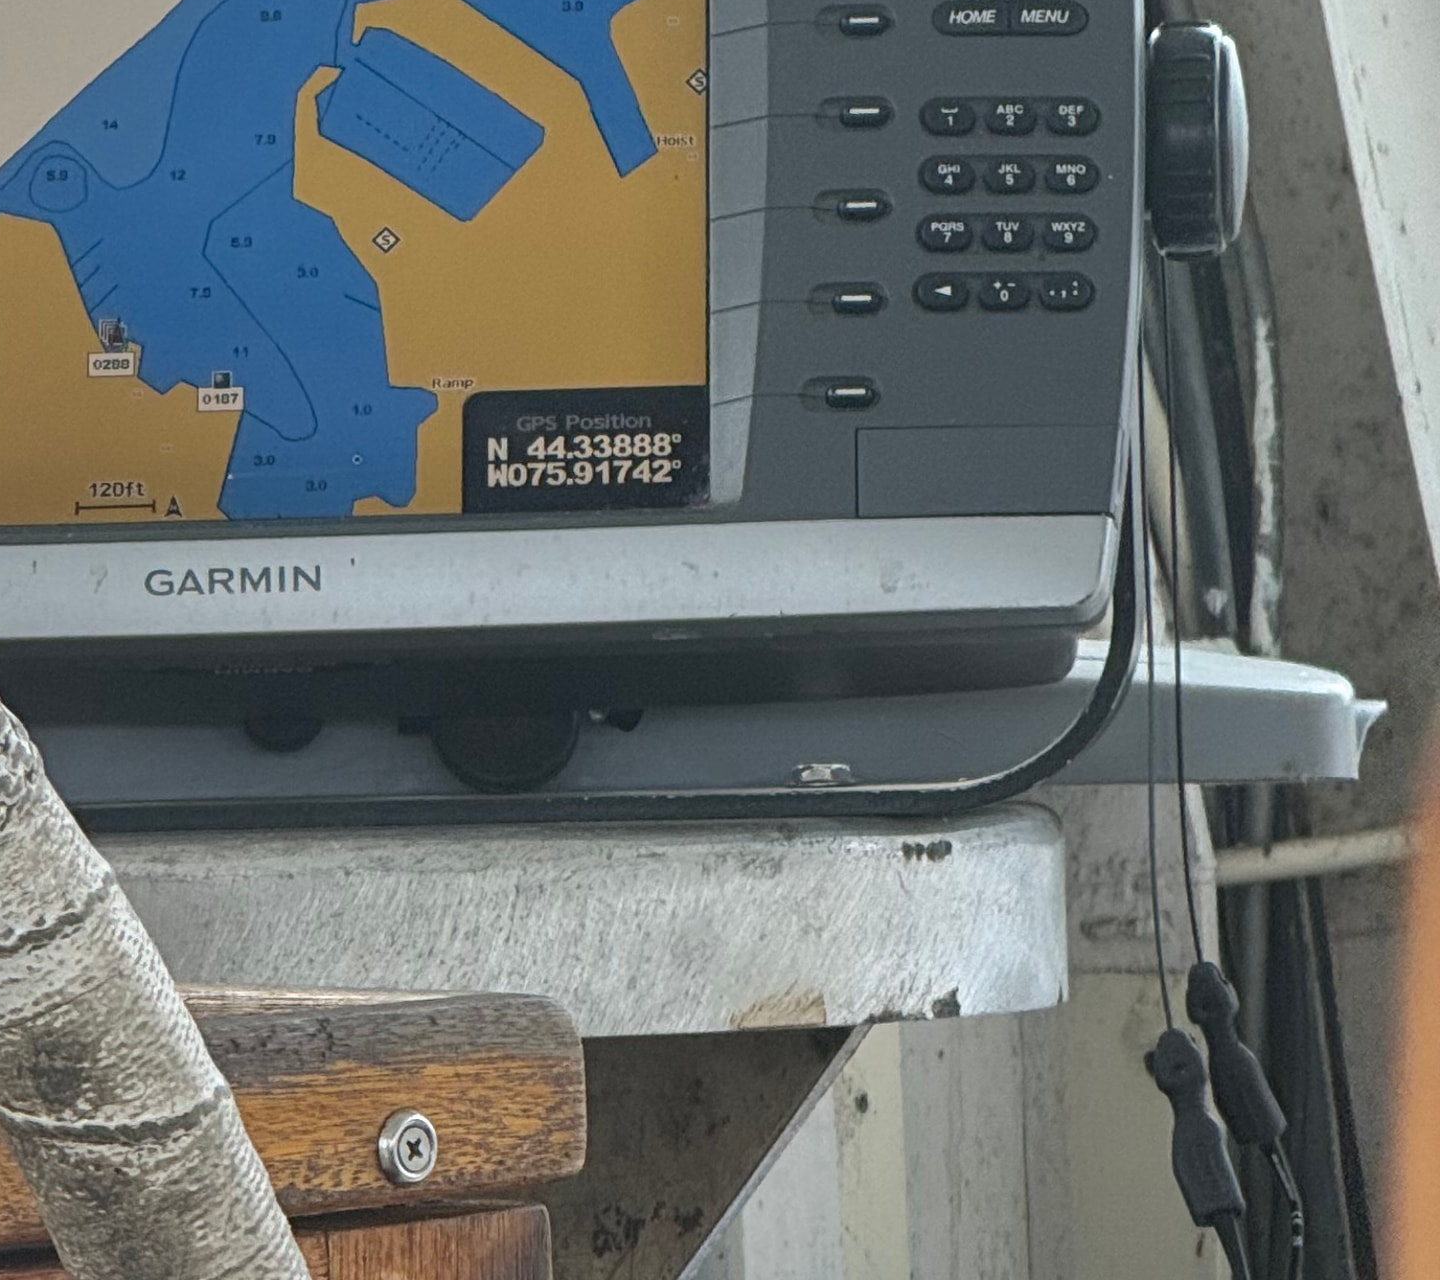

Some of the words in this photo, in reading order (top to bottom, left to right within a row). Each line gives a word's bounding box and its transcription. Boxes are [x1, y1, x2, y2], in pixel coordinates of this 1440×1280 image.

[949, 9, 998, 25] HOME
[1021, 9, 1070, 24] MENU
[996, 105, 1024, 115] ABC
[1059, 105, 1084, 115] DEF
[1006, 115, 1014, 126] 2
[1067, 115, 1076, 127] 3
[657, 135, 695, 147] Hoist
[937, 164, 961, 174] GHI
[998, 164, 1021, 174] JKL
[1056, 164, 1086, 175] MNO
[944, 175, 953, 185] 4
[1005, 174, 1014, 185] 5
[1066, 175, 1076, 186] 6
[931, 222, 964, 232] PQRS
[996, 222, 1019, 232] TUV
[1051, 222, 1086, 232] WXYZ
[943, 232, 951, 243] 7
[1003, 232, 1013, 243] 8
[1064, 232, 1073, 243] 9
[92, 359, 130, 371] 0288
[432, 378, 475, 391] Ramp
[202, 393, 239, 405] 0187
[516, 416, 558, 433] GPS
[566, 413, 653, 431] Position
[487, 437, 508, 461] N
[527, 433, 682, 460] 44.33888°
[88, 482, 145, 498] 120ft
[144, 565, 322, 597] GARMIN
